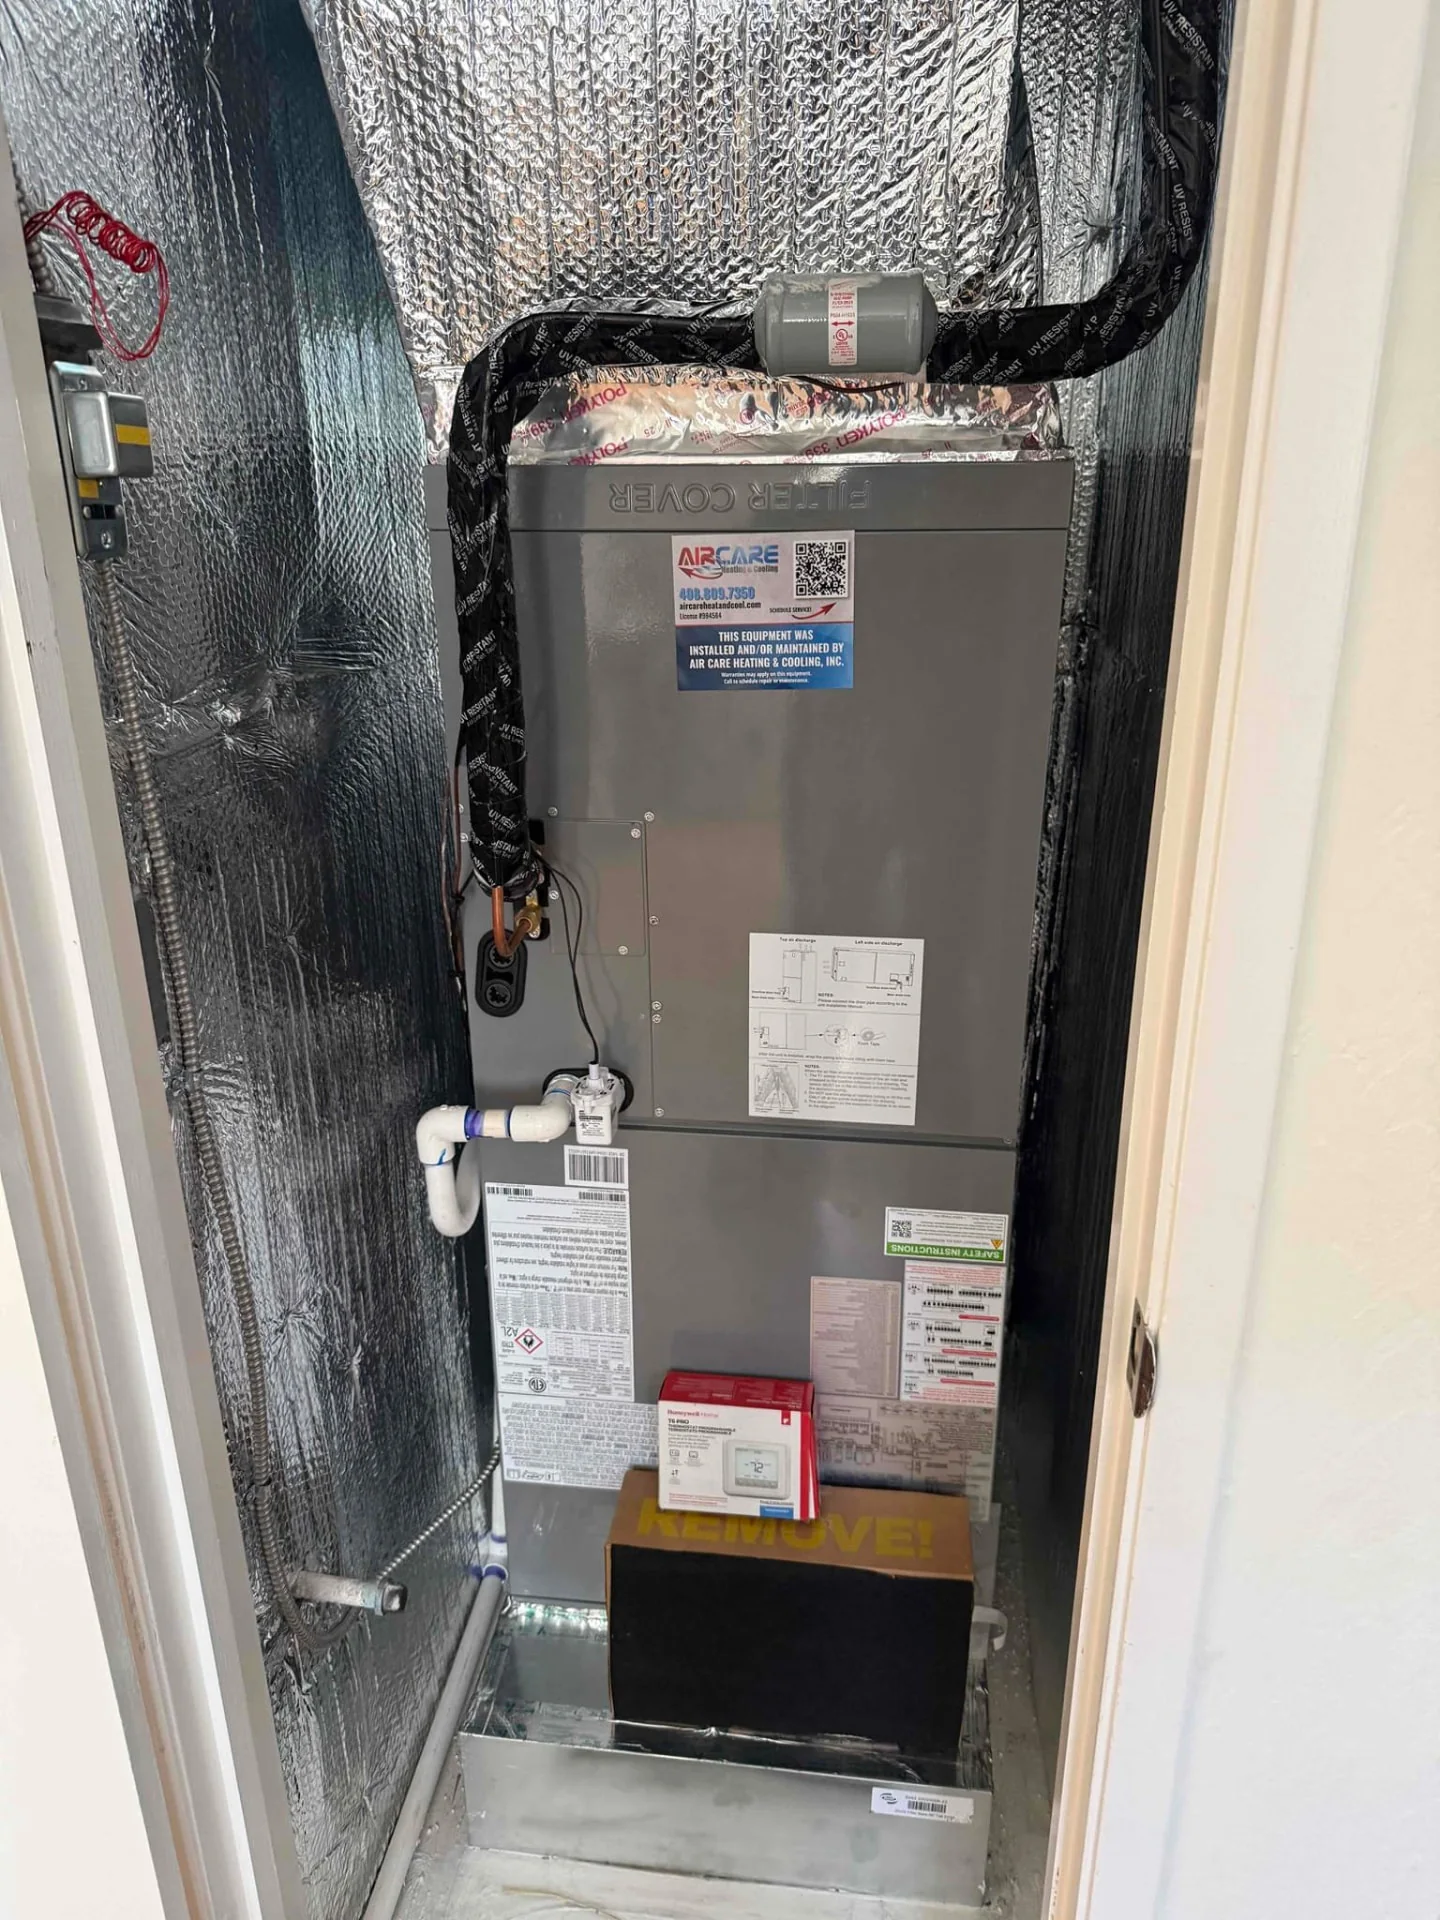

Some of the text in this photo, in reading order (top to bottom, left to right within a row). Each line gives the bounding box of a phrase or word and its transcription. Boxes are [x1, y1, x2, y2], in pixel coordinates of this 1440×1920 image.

[1176, 13, 1214, 71] RESISTANT
[1173, 184, 1185, 199] UV
[1027, 341, 1041, 356] UV
[530, 420, 556, 438] 339
[835, 406, 908, 450] POLYKEN
[805, 441, 831, 462] 339
[608, 480, 873, 514] FILTER COVER
[753, 565, 779, 573] Cooling
[679, 601, 761, 610] aircareheatandcool.com
[718, 629, 814, 643] THIS EQUIPMENT WAS
[689, 642, 844, 656] INSTALLED AND/OR MAINTAINED BY
[689, 656, 844, 669] AIR CARE HEATING & COOLING, INC.
[891, 1244, 1000, 1259] SAFETY INSTRUCTIONS
[500, 1326, 519, 1337] A2L
[667, 1409, 700, 1417] Honeywell
[750, 1461, 764, 1474] 72
